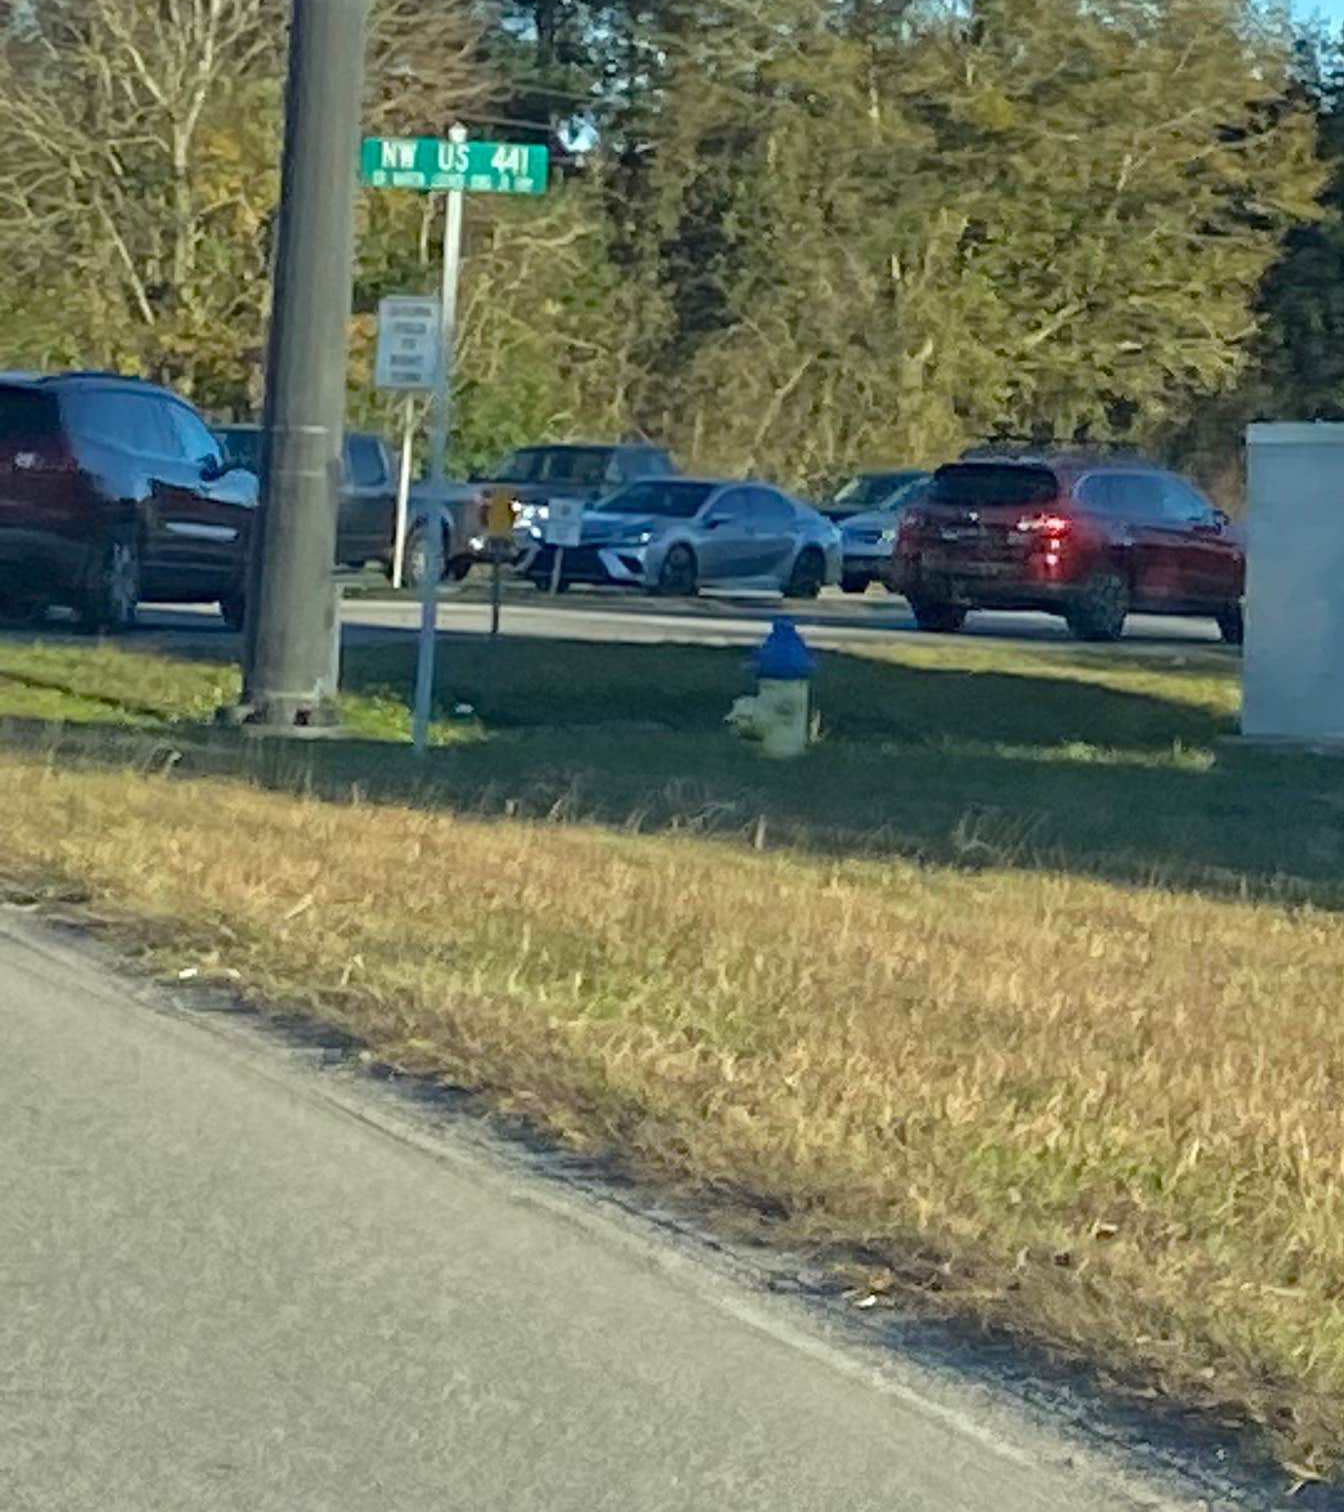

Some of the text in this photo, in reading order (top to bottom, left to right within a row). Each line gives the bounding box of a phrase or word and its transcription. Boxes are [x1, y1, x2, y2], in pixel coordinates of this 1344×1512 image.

[380, 141, 530, 176] NW US 441
